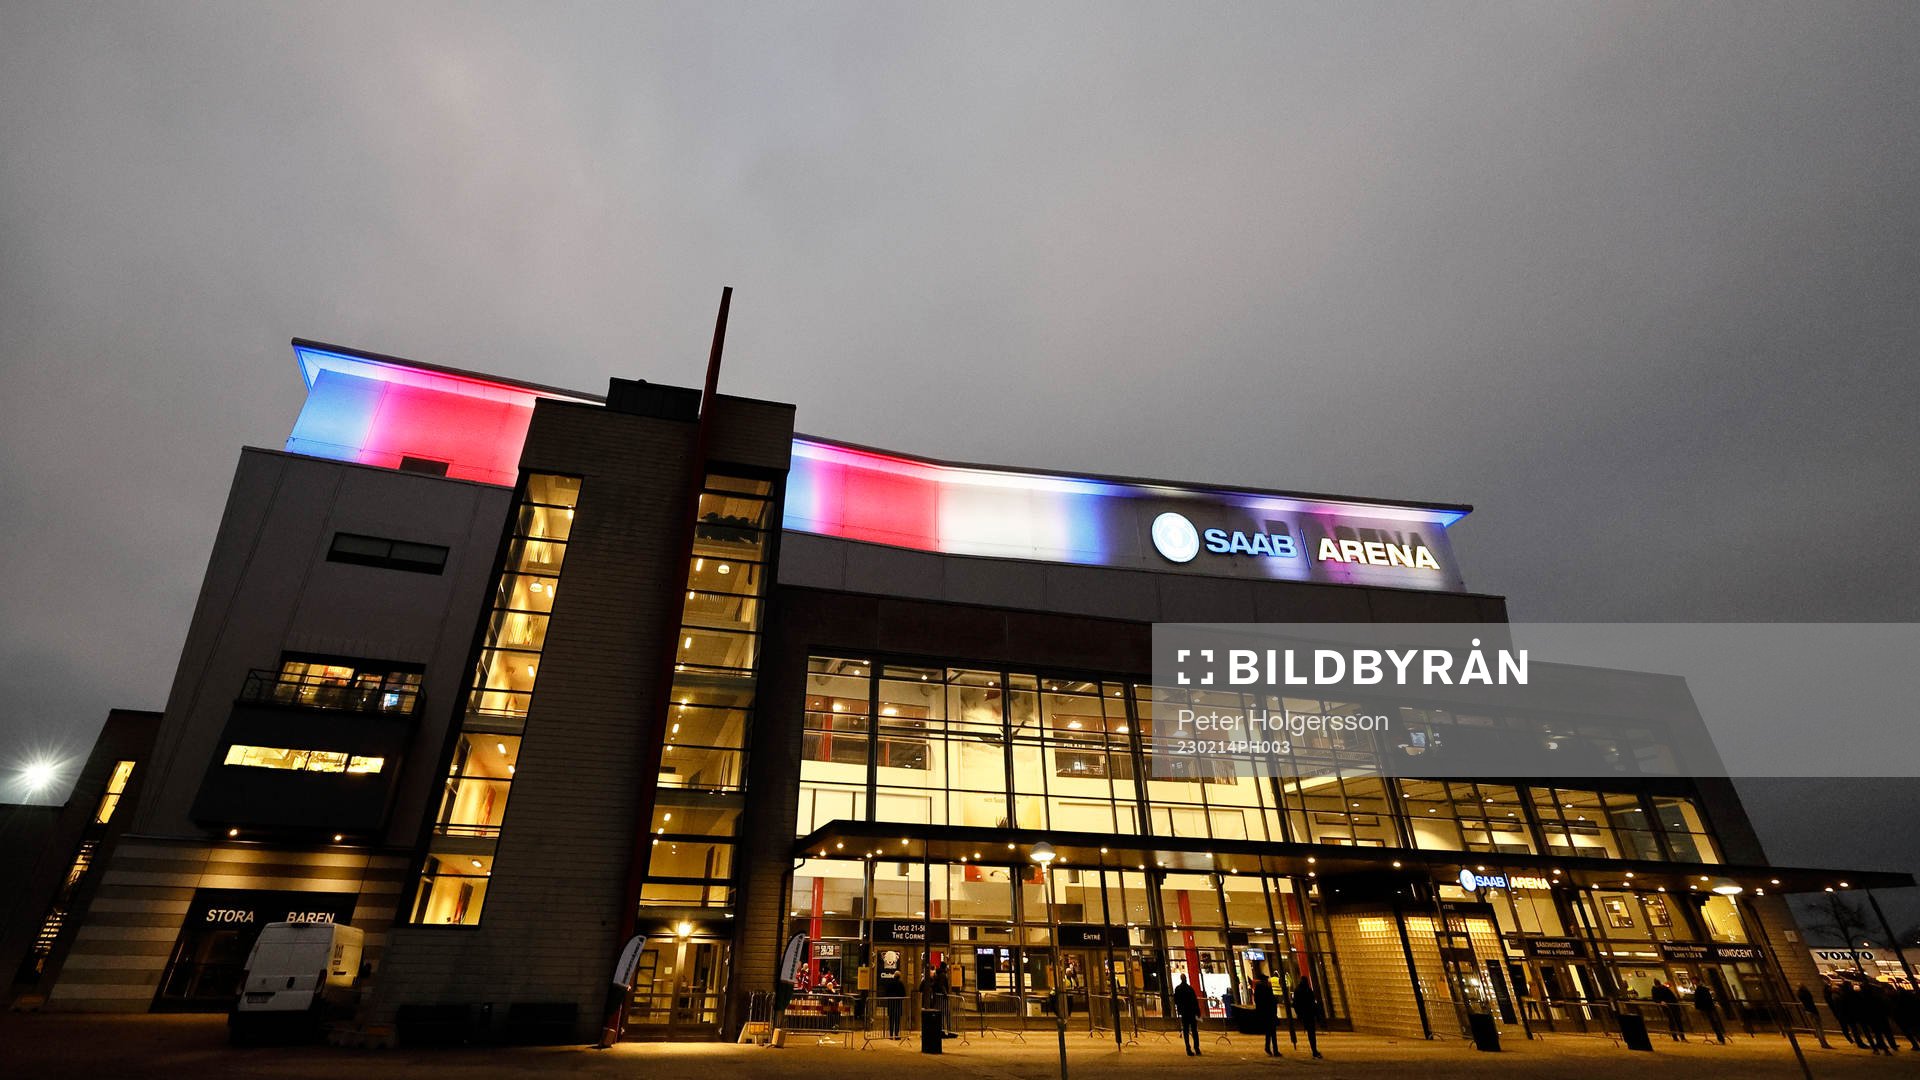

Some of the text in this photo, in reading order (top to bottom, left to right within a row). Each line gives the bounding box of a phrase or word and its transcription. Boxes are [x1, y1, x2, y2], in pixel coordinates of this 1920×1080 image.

[1204, 528, 1441, 570] SAAB ARENA
[1475, 875, 1552, 890] SAAB ARENA
[206, 909, 255, 923] STORA
[904, 932, 926, 940] CORNE
[1816, 951, 1874, 960] VOLVO
